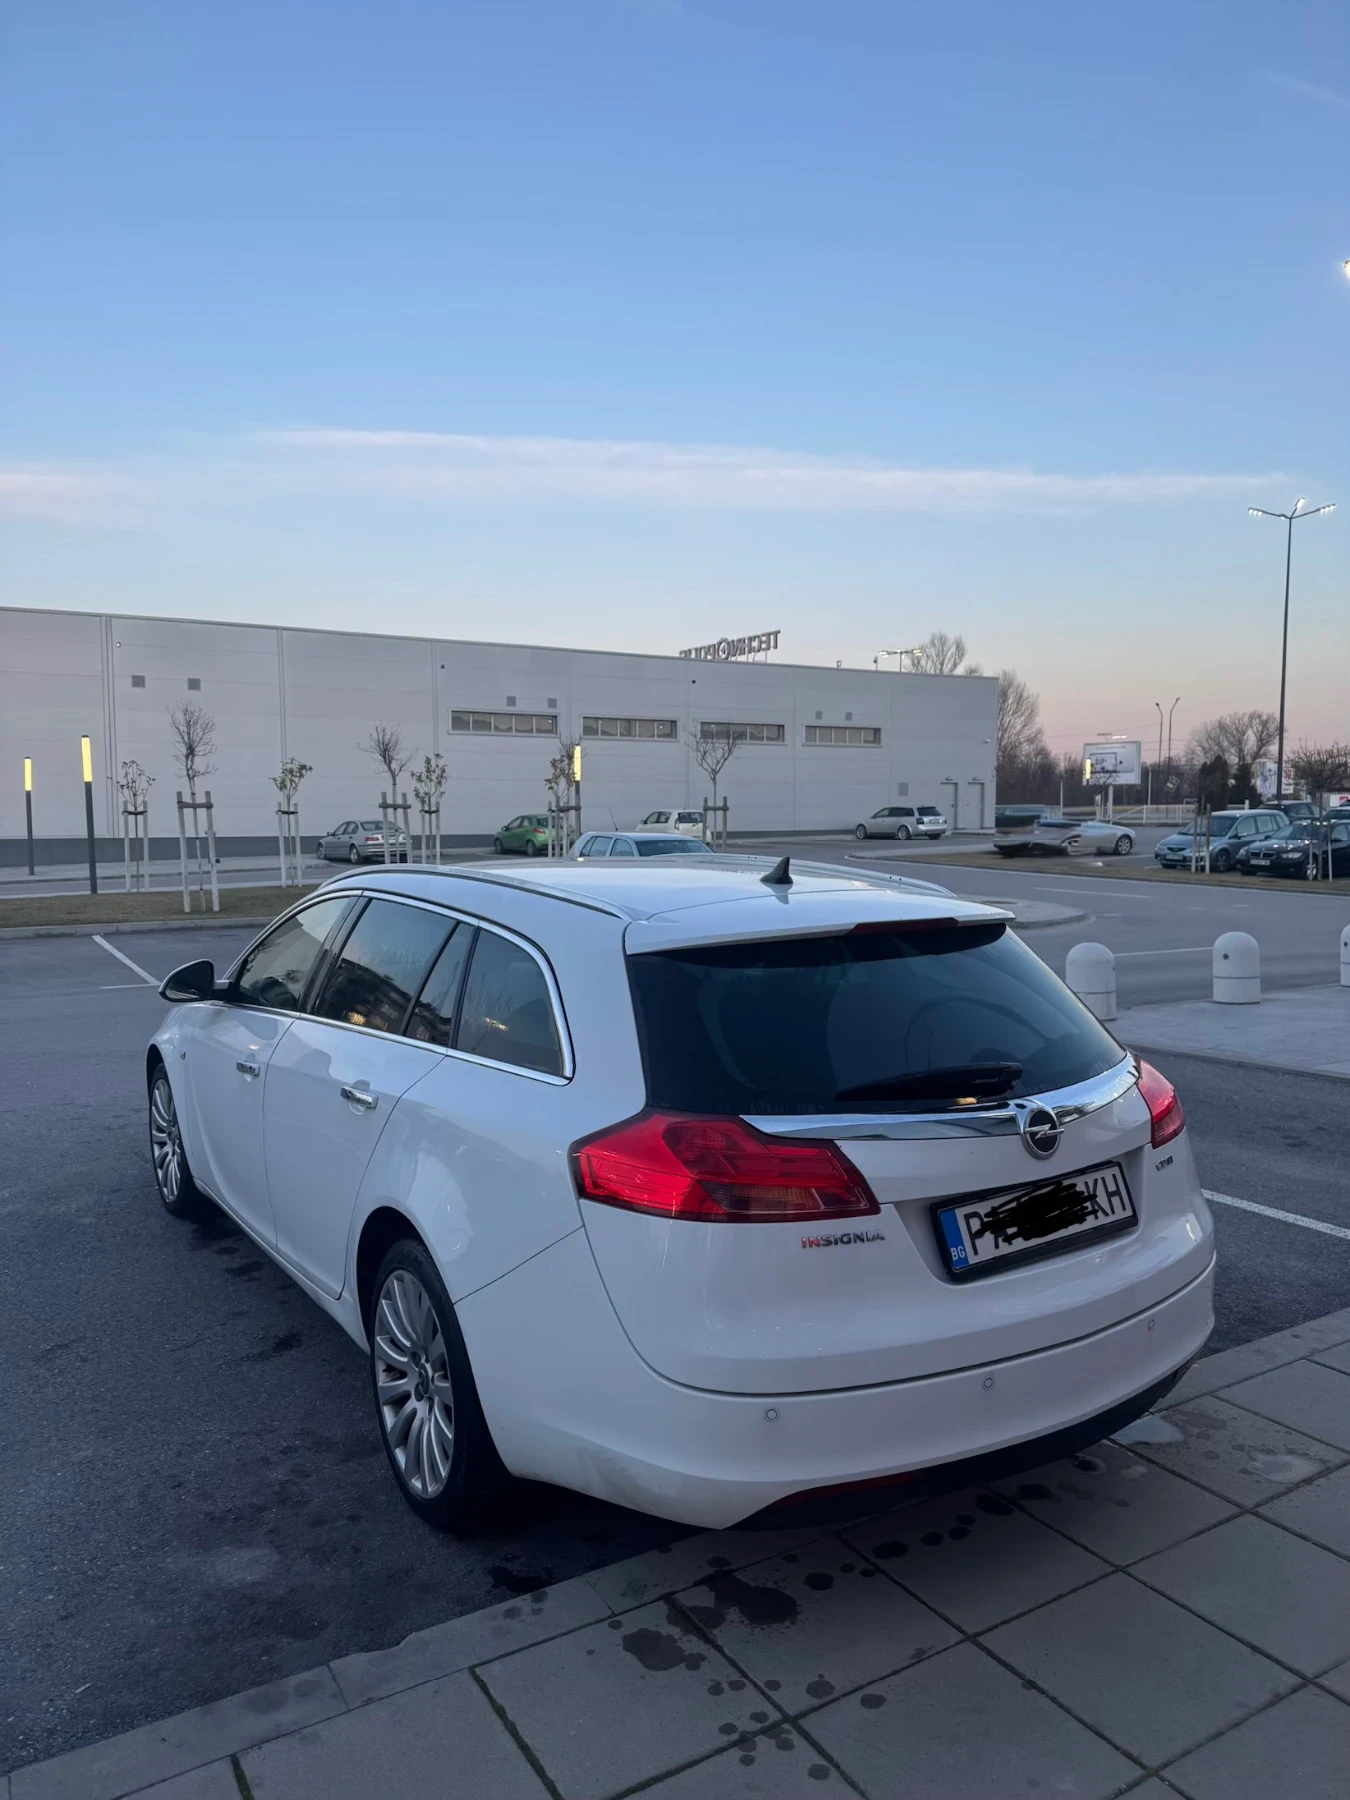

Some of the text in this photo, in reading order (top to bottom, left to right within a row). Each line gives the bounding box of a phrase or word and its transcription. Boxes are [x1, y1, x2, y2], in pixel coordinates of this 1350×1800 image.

[1084, 1173, 1126, 1220] KH
[801, 1229, 886, 1249] INSIGNIA
[951, 1245, 966, 1261] BG
